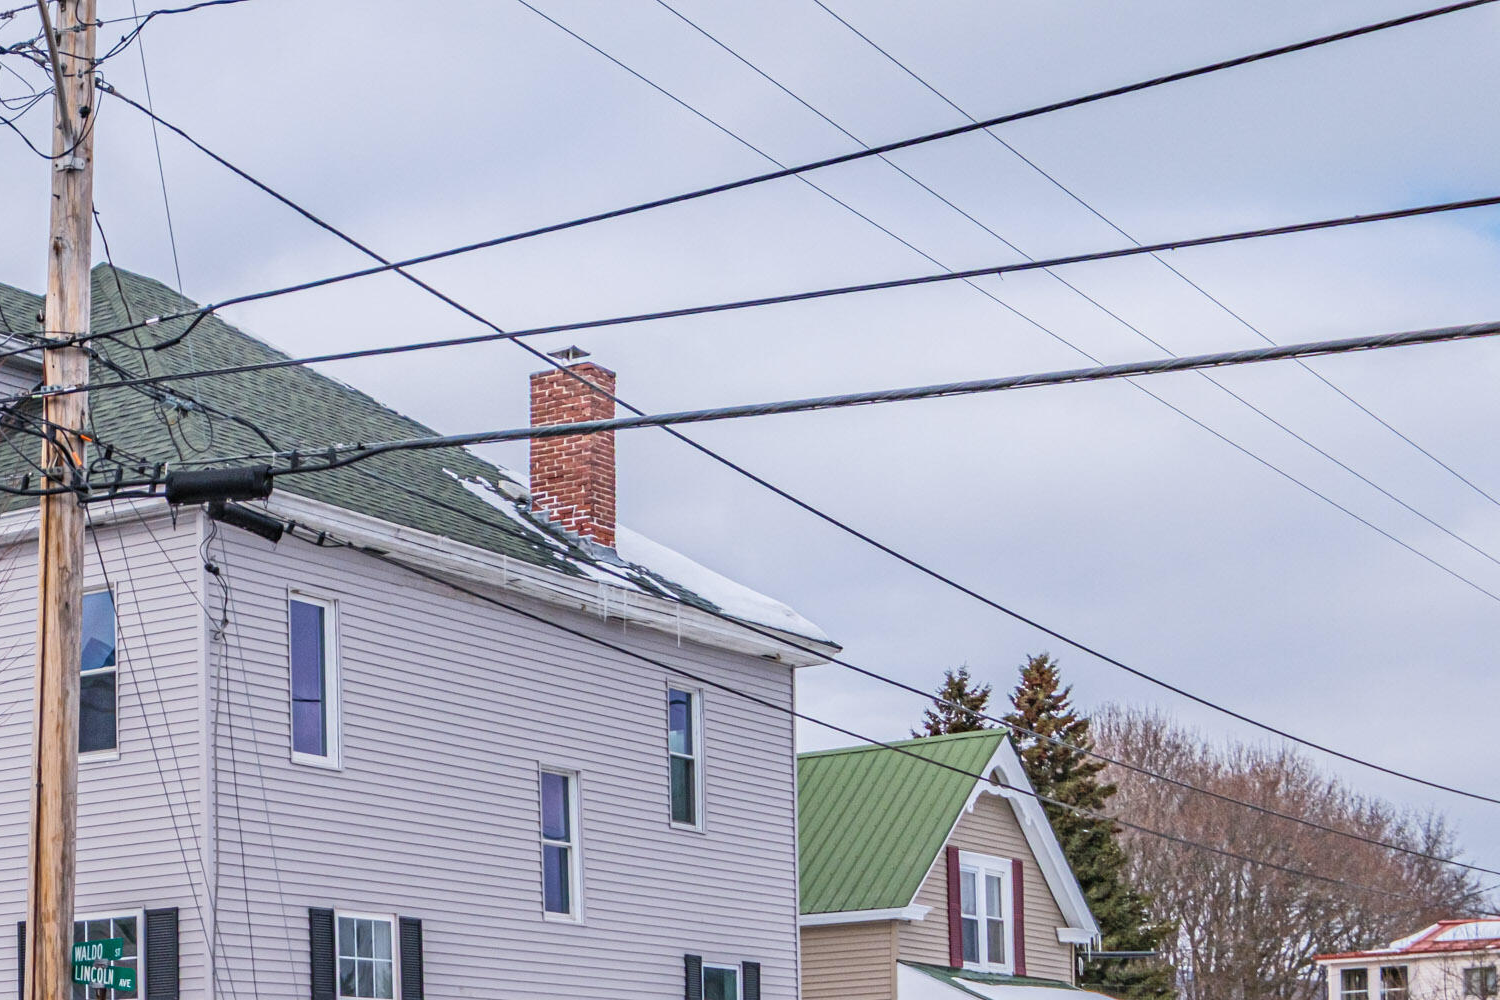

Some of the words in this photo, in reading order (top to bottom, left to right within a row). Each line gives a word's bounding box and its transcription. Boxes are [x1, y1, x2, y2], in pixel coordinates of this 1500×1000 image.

[74, 943, 103, 961] WALDO
[115, 948, 121, 957] ST
[75, 965, 114, 985] LINCOLN
[119, 979, 132, 988] AVE
